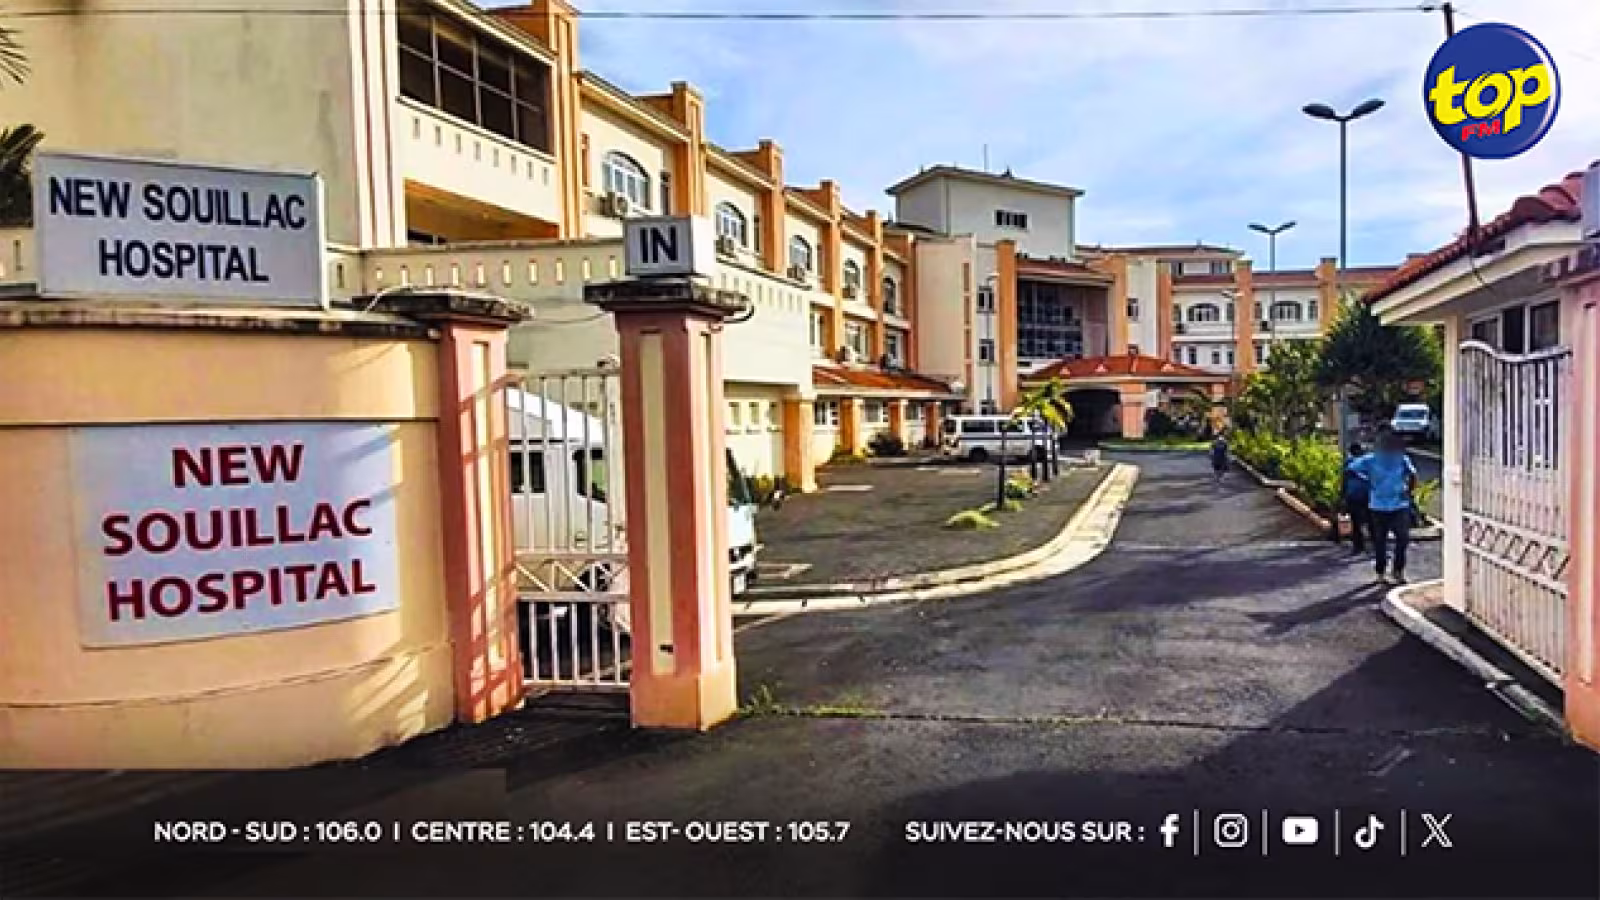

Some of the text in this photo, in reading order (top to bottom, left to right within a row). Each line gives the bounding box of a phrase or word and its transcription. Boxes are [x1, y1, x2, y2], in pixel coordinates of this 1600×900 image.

[49, 176, 307, 230] NEW SOUILLAC
[99, 239, 270, 283] HOSPITAL
[640, 225, 679, 264] IN
[171, 444, 305, 488] NEW
[101, 499, 373, 556] SOUILLAC
[107, 558, 376, 622] HOSPITAL
